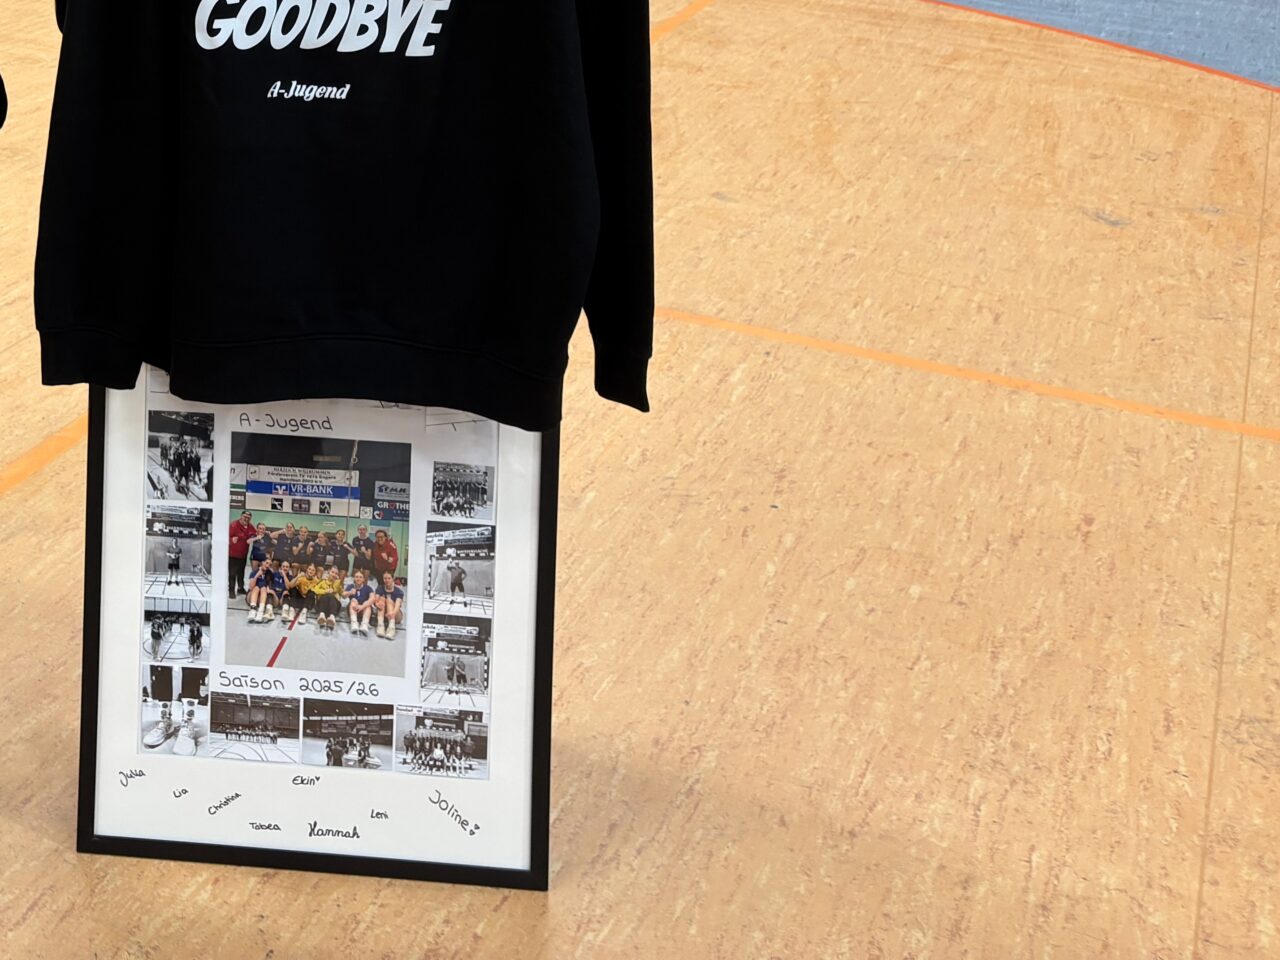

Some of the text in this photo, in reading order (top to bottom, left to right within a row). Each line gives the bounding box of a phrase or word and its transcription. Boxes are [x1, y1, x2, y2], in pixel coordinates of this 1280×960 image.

[267, 80, 351, 101] A-Jugend
[219, 671, 379, 697] Saison 2025/26
[173, 788, 189, 799] Lia
[207, 792, 242, 816] Christina
[428, 789, 469, 831] Joline
[249, 821, 282, 831] Tabea
[308, 820, 361, 839] Hannah
